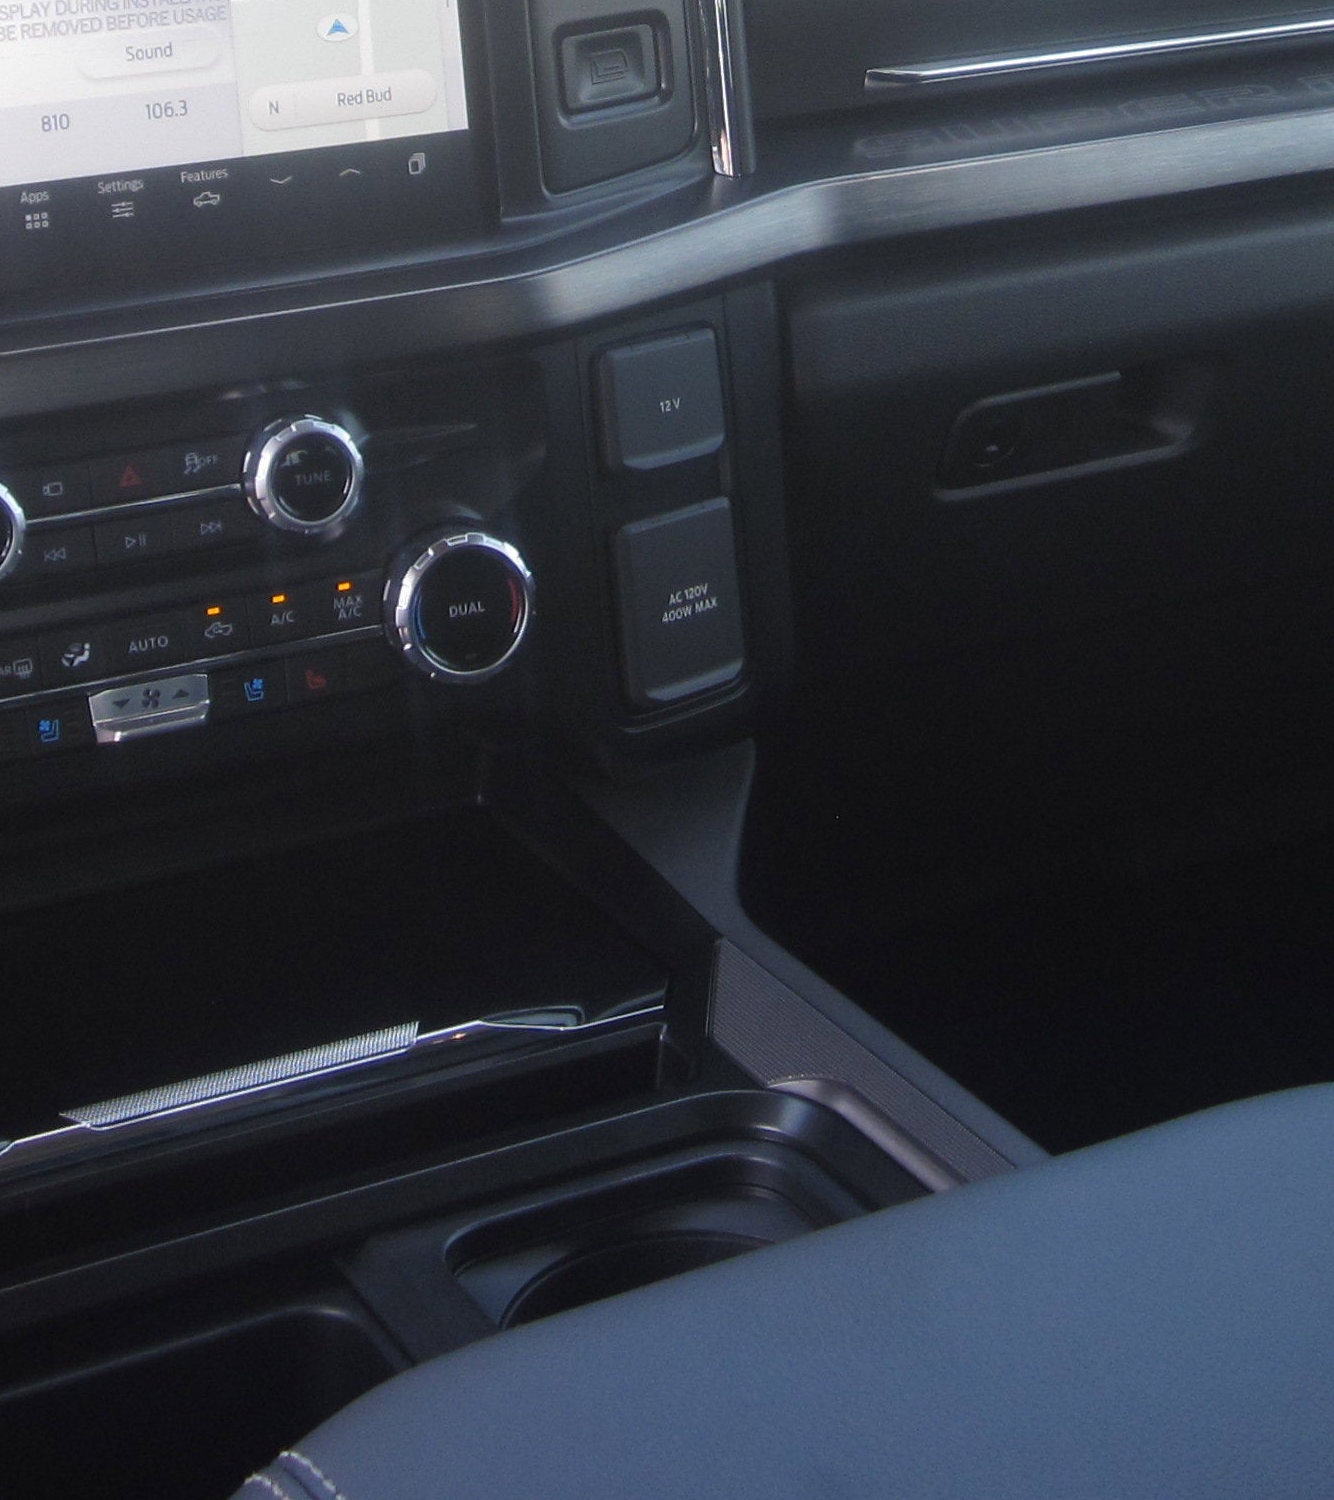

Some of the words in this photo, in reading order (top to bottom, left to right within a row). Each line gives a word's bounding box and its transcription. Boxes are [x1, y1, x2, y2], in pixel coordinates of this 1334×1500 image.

[21, 16, 102, 39] REMOVED
[106, 9, 171, 31] BEFORE
[173, 4, 227, 25] USAGE
[125, 42, 173, 62] Sound
[145, 100, 188, 121] 106.3
[269, 100, 279, 115] N
[337, 90, 363, 107] Red
[366, 87, 392, 104] Bud
[41, 113, 70, 133] 810
[180, 166, 229, 182] Features
[97, 177, 144, 196] Settings
[20, 189, 49, 206] Apps
[293, 469, 332, 486] TUNE
[333, 593, 364, 610] MAX
[669, 590, 683, 605] AC
[684, 582, 708, 601] 120V
[269, 609, 296, 627] A/C
[337, 605, 364, 622] A/C
[448, 600, 486, 617] DUAL
[661, 604, 693, 624] 400W
[695, 596, 718, 614] MAX
[127, 634, 170, 656] AUTO
